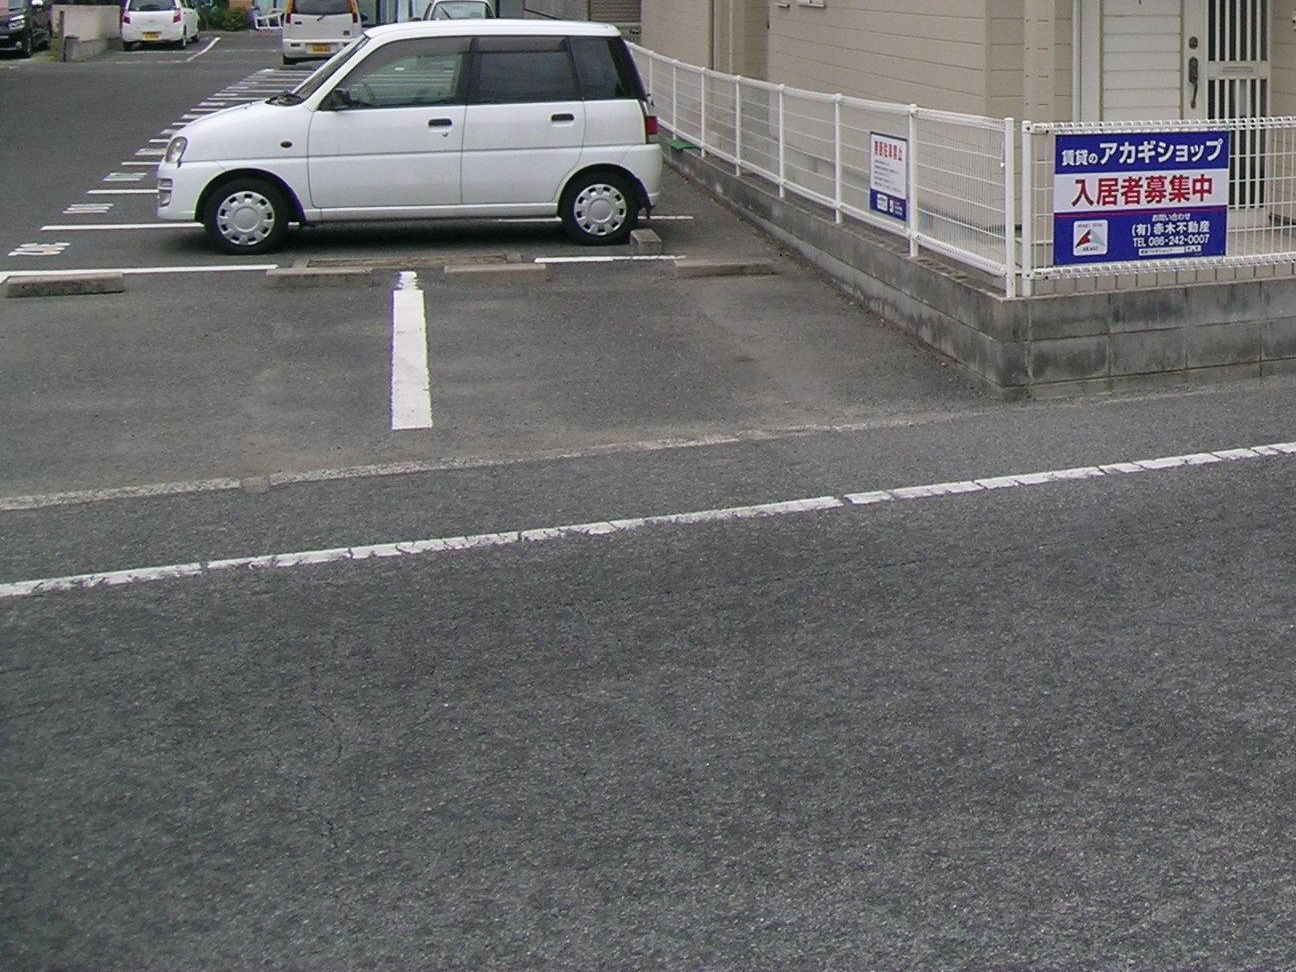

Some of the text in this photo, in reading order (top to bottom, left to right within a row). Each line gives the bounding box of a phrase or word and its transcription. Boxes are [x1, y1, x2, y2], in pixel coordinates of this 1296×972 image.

[1061, 138, 1224, 166] 賃貸のアカギショップ
[1072, 174, 1213, 207] 入居者募集中
[1133, 238, 1147, 247] TEL
